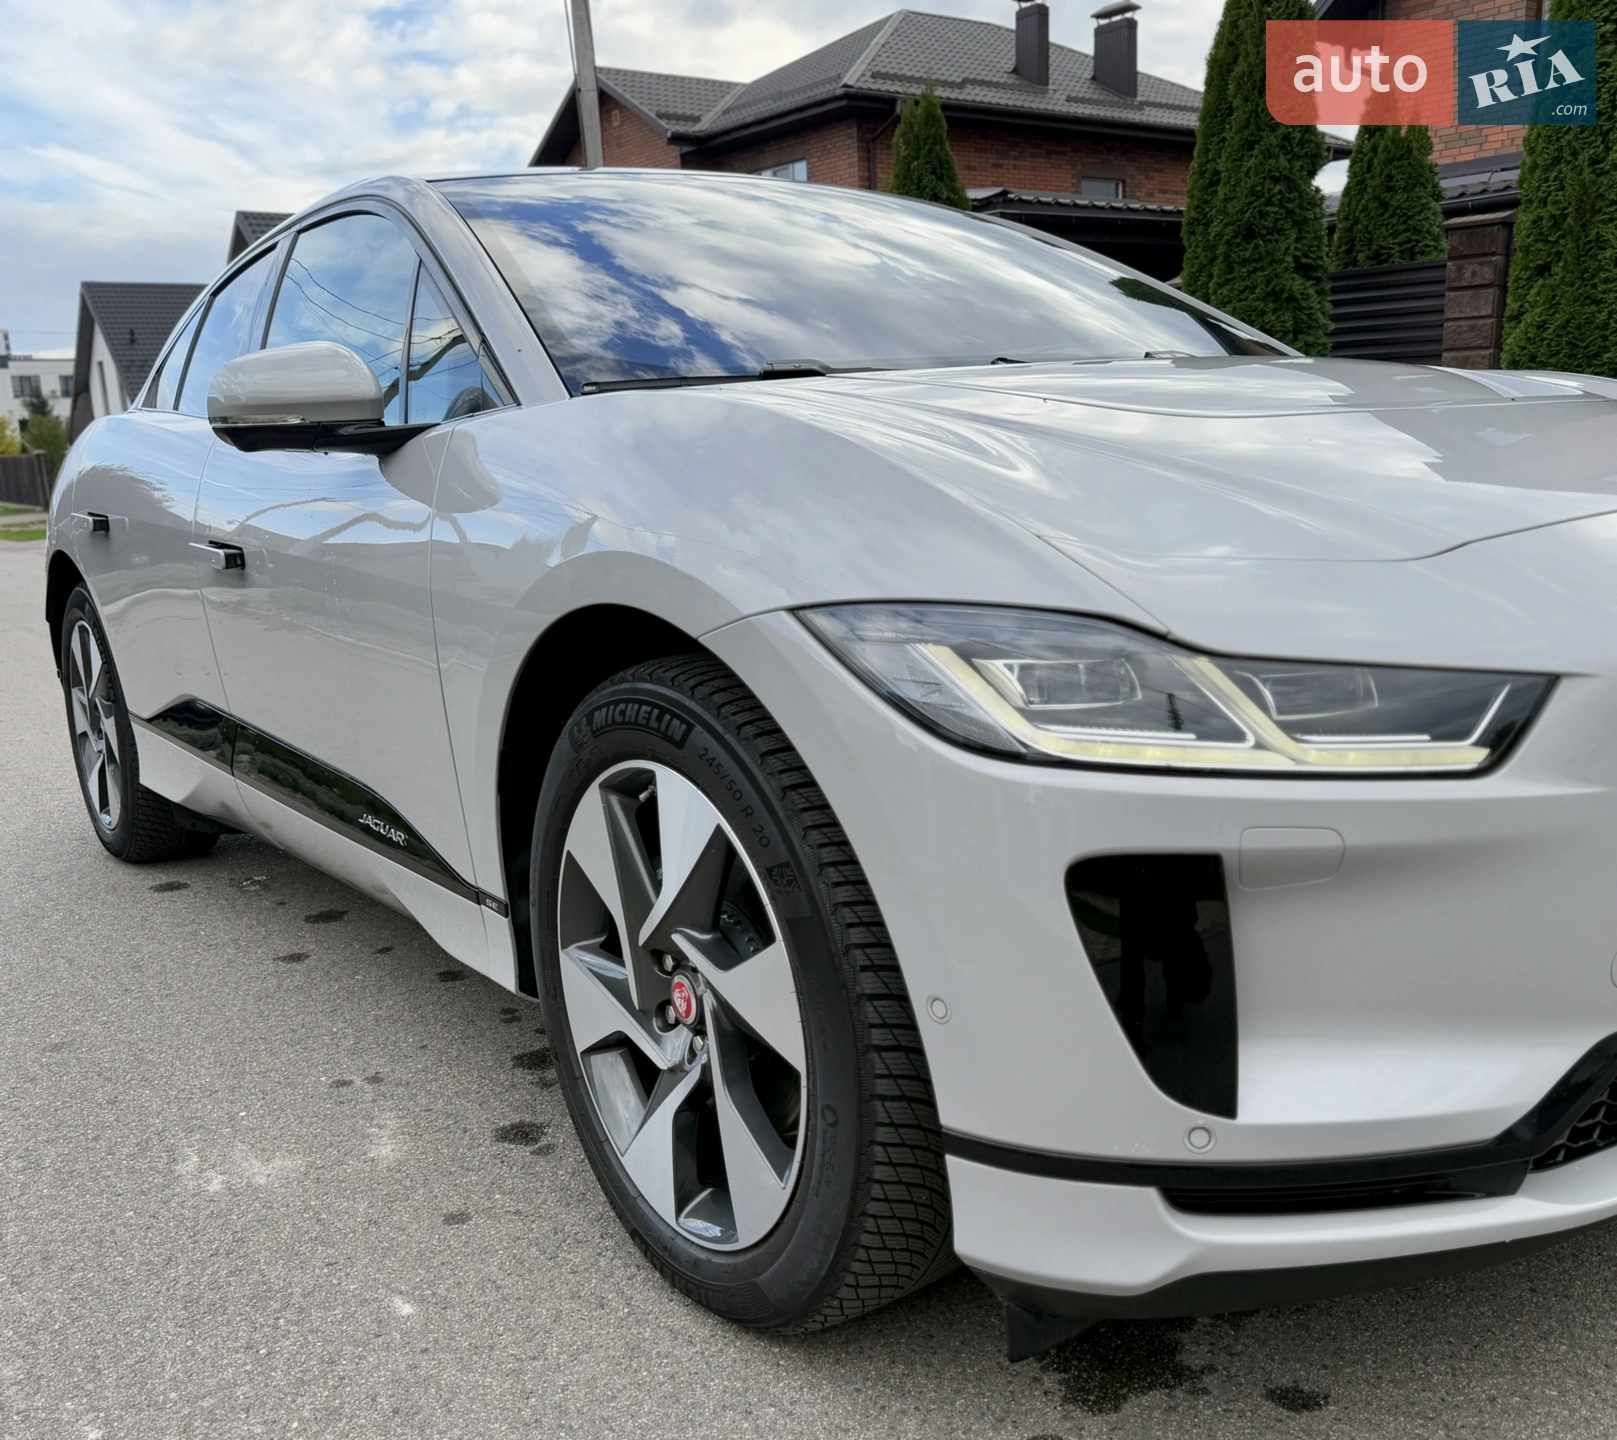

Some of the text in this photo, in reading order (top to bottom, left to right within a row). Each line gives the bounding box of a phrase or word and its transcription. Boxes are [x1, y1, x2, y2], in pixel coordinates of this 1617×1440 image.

[592, 703, 688, 742] MICHELIN
[698, 747, 771, 848] 245/50 R 20
[358, 813, 406, 847] JAGUAR
